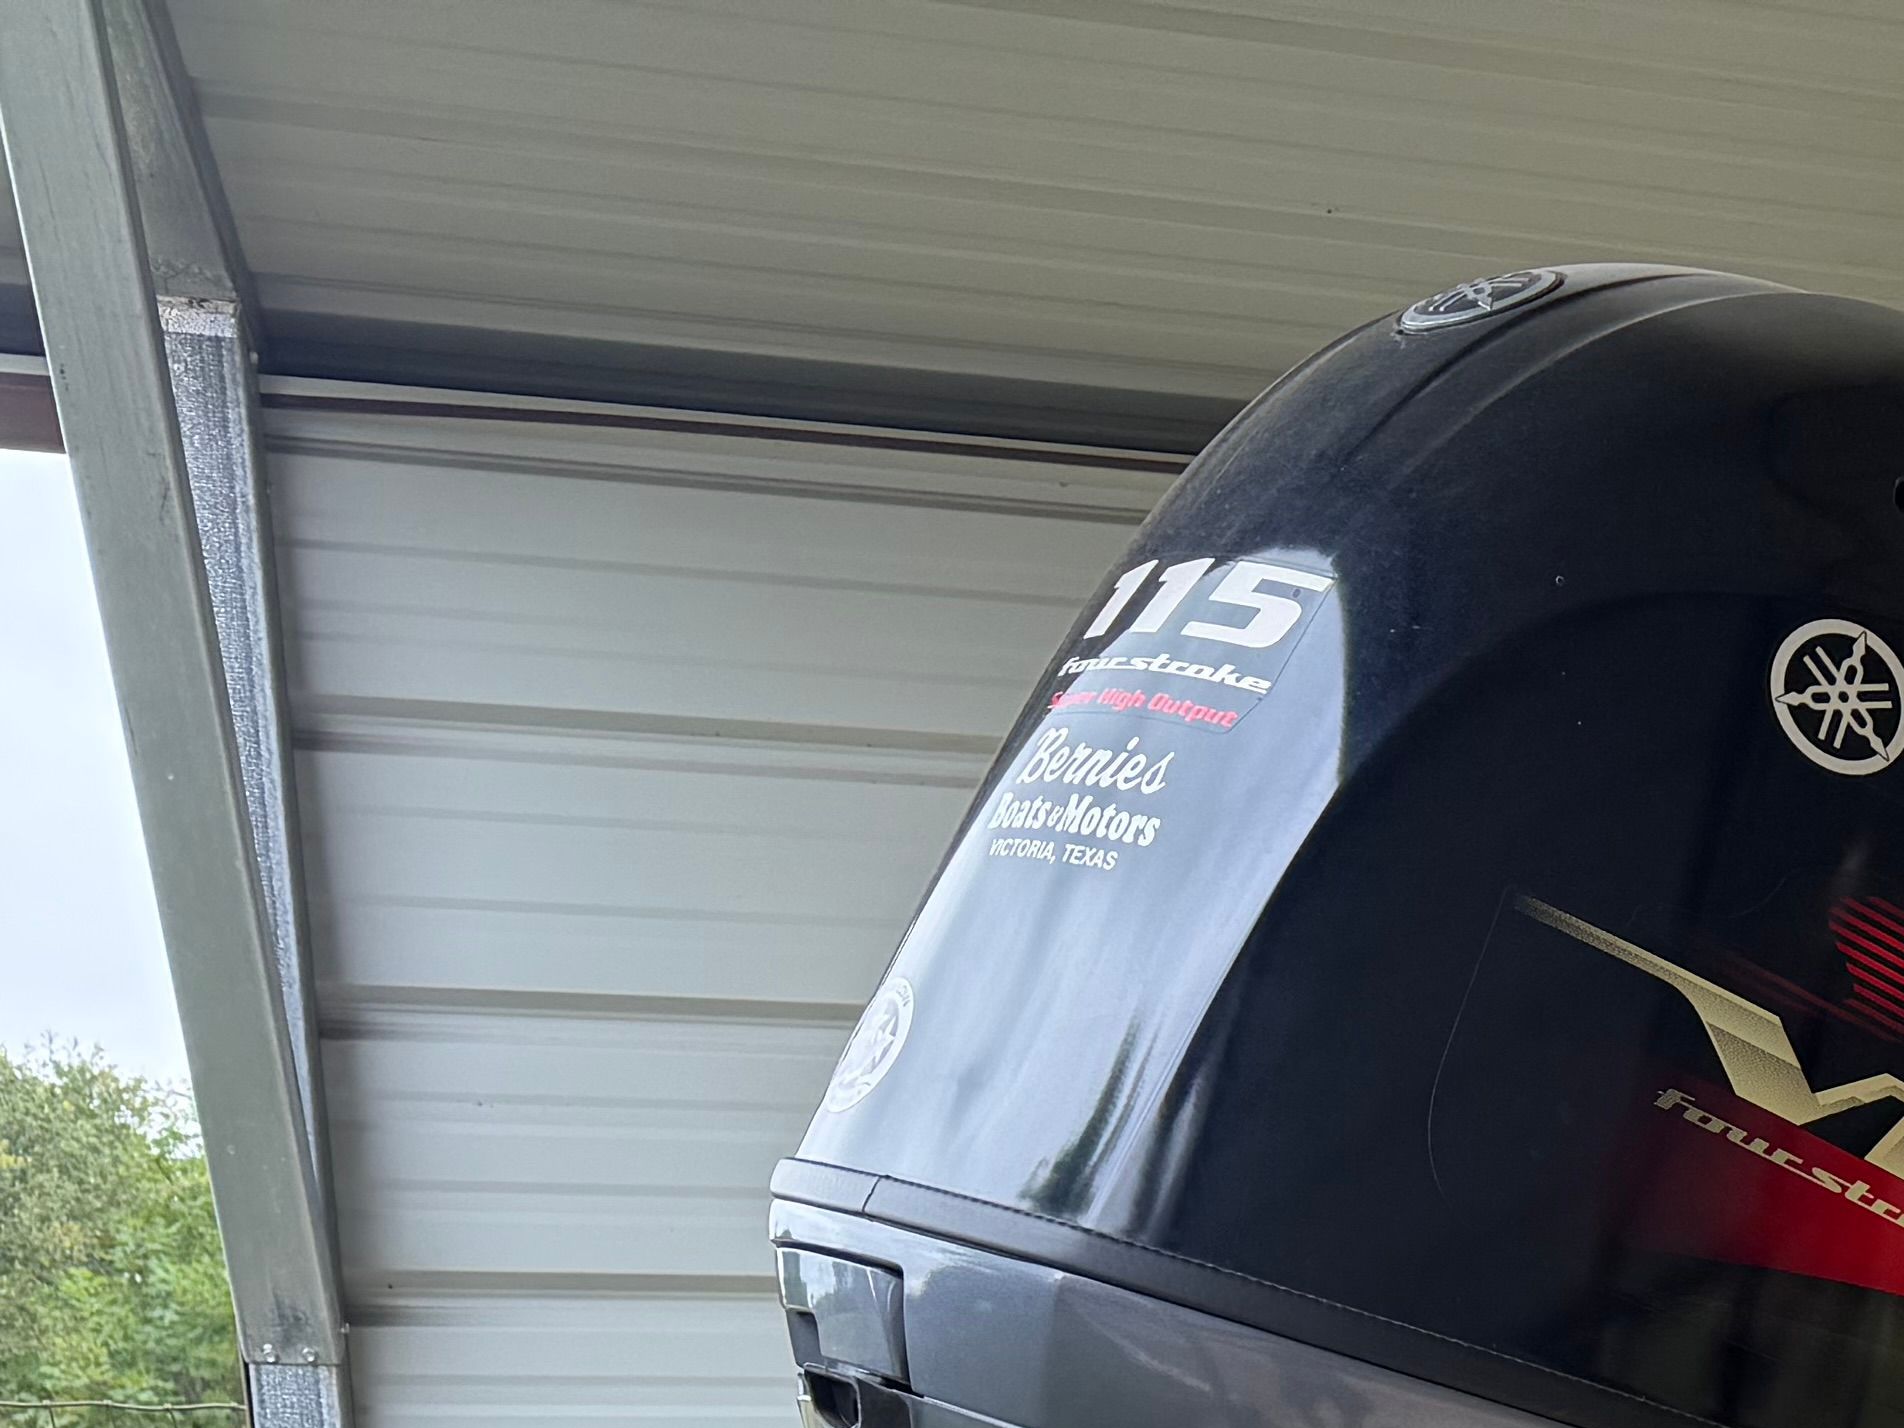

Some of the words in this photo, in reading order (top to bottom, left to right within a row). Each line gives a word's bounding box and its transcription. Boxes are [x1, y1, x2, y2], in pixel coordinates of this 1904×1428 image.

[1083, 557, 1336, 648] 115
[1097, 687, 1146, 711] High
[1148, 692, 1239, 728] Output
[1016, 727, 1175, 795] Bernies
[989, 838, 1056, 864] VICTORIA,
[1062, 844, 1119, 871] TEXAS
